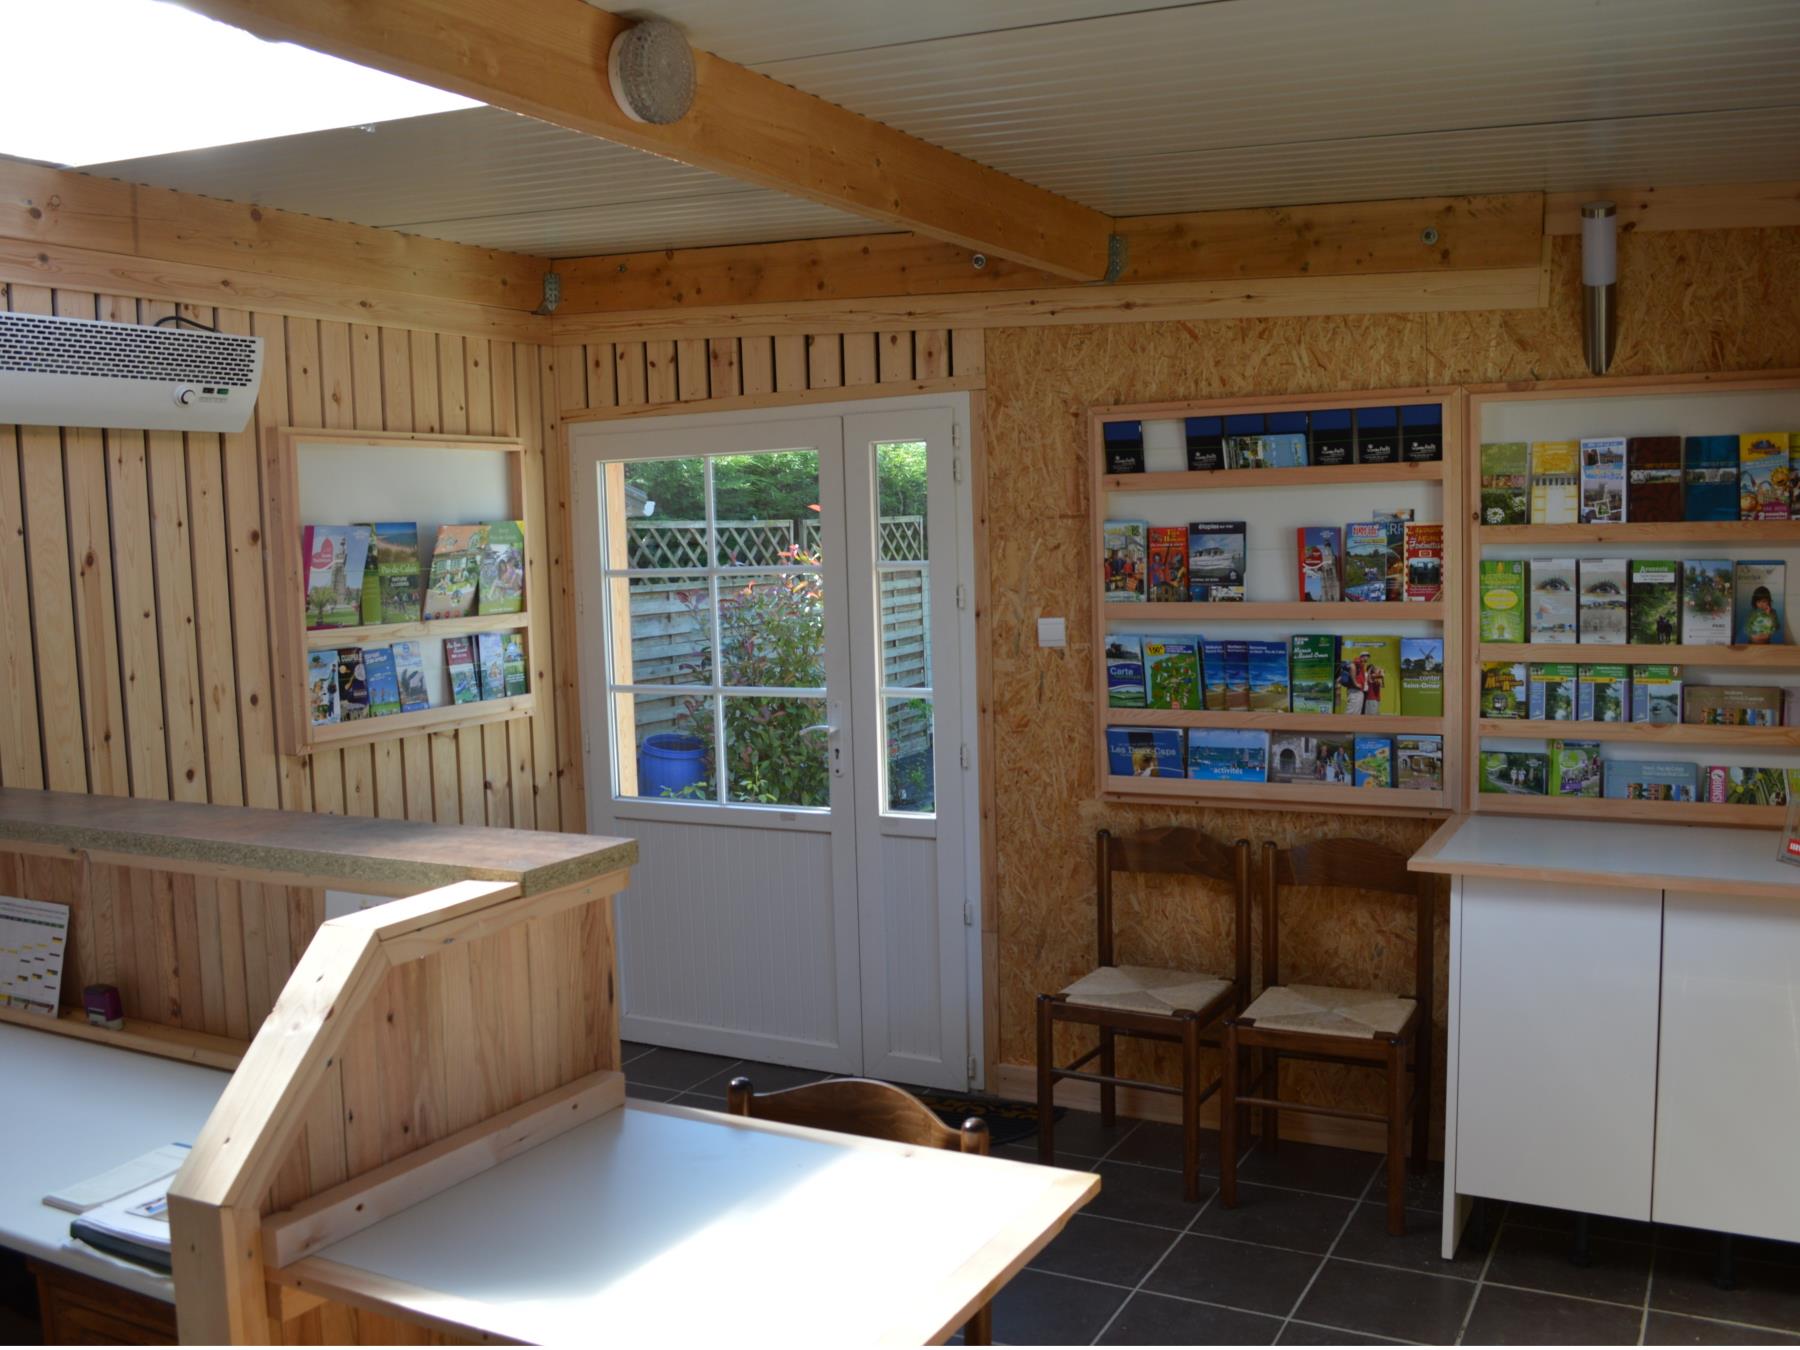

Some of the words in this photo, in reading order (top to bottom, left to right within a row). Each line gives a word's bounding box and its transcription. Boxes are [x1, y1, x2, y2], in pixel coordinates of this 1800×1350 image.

[1110, 667, 1134, 676] Carte
[1110, 745, 1126, 754] Les
[1213, 766, 1244, 776] activités
